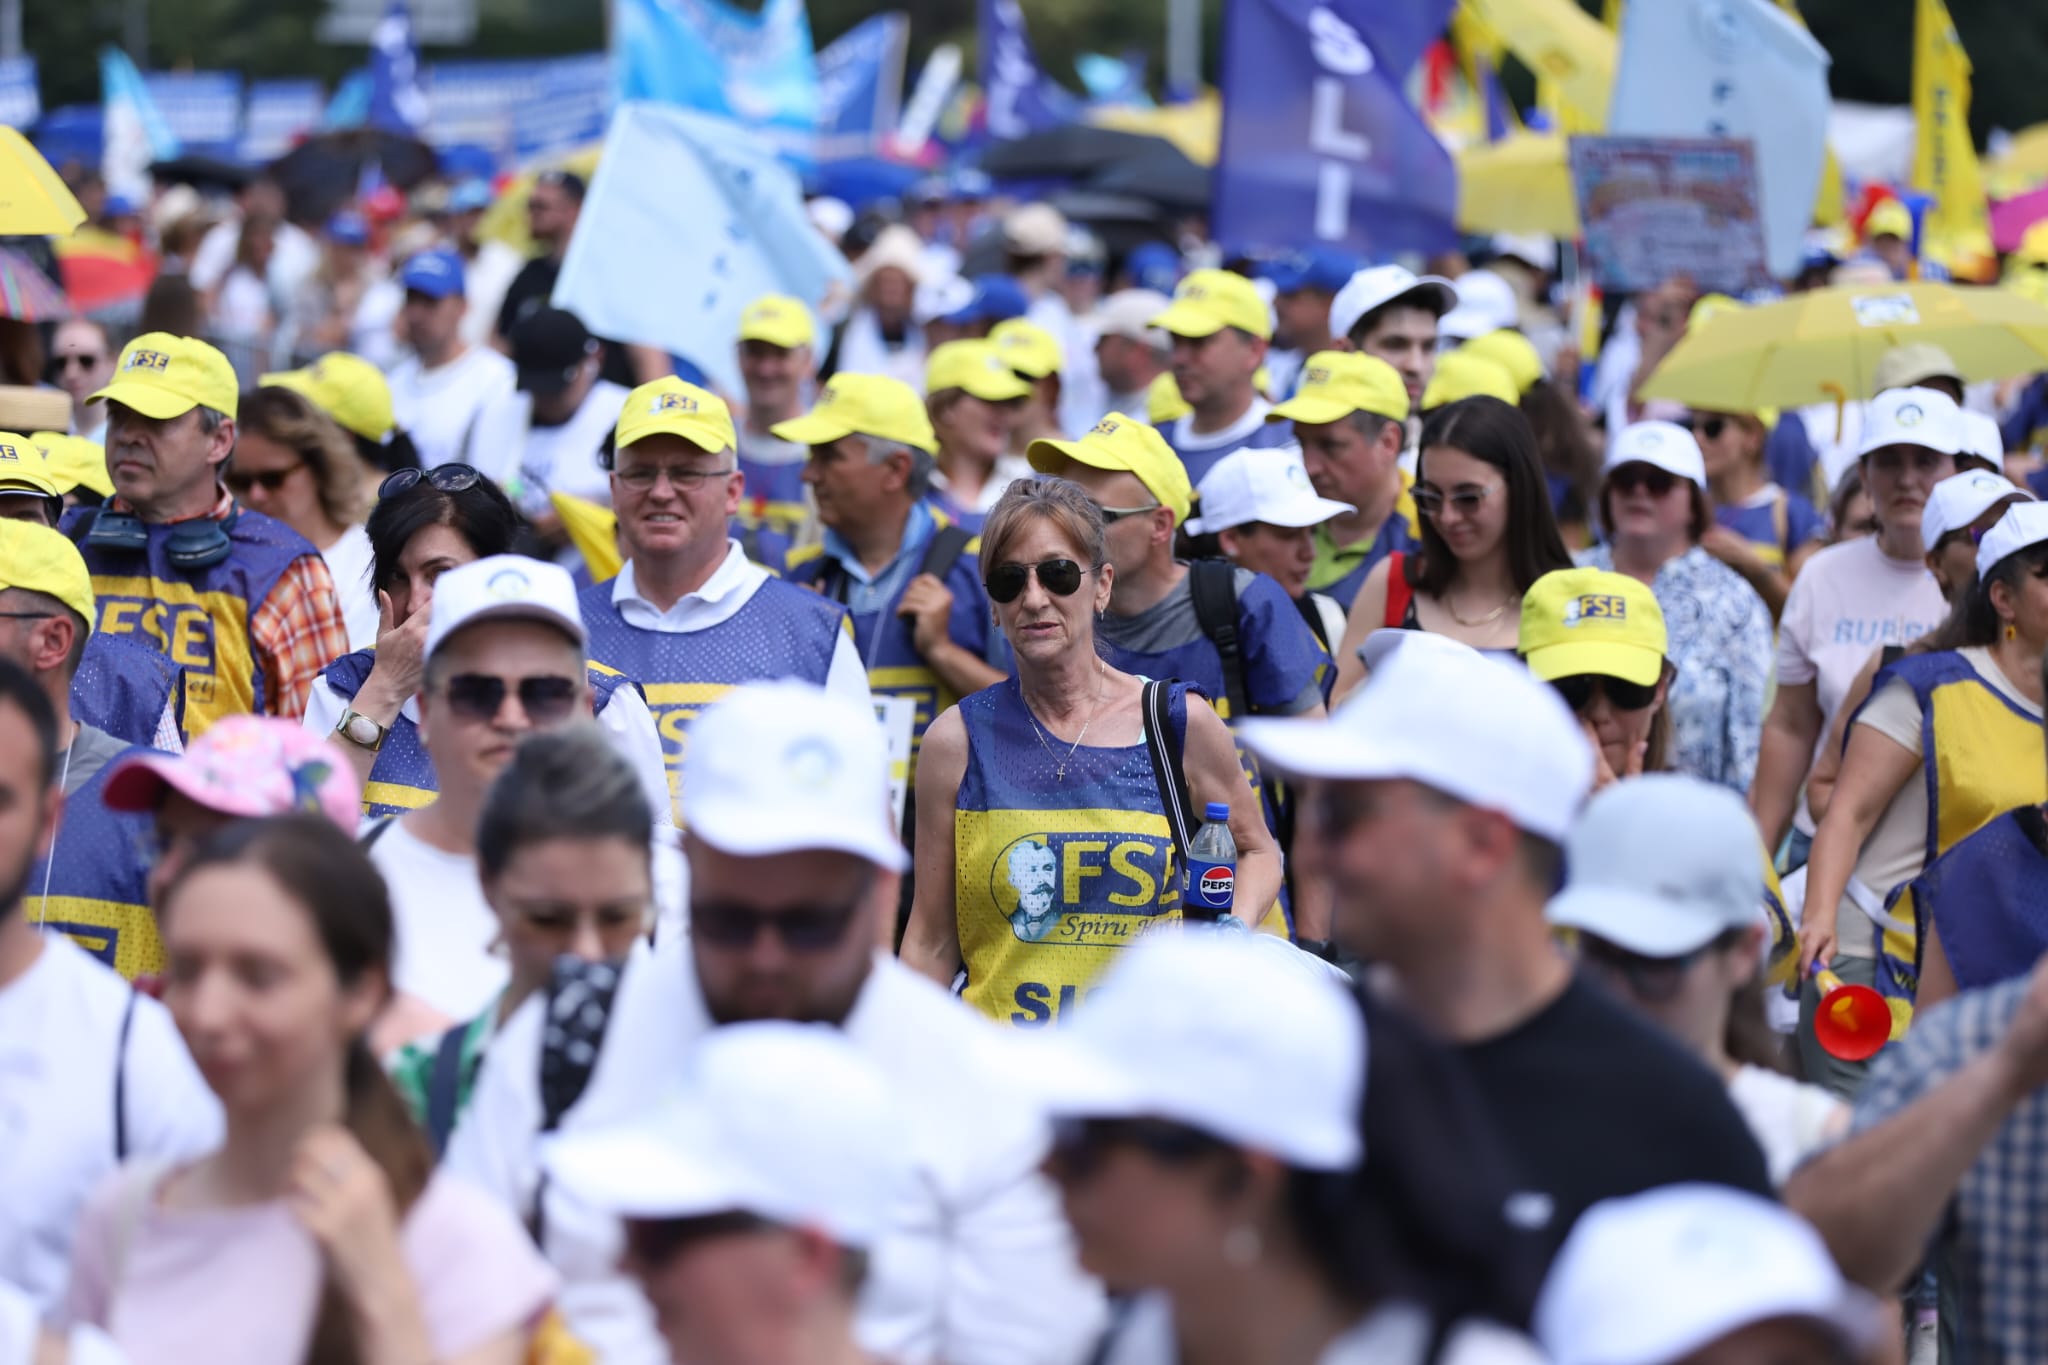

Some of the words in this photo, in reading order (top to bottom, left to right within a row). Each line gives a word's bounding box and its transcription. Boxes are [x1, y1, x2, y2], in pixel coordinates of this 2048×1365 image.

[135, 351, 169, 370] FSE
[1580, 596, 1624, 618] FSE
[99, 601, 210, 667] FSE
[1060, 915, 1128, 942] Spiru
